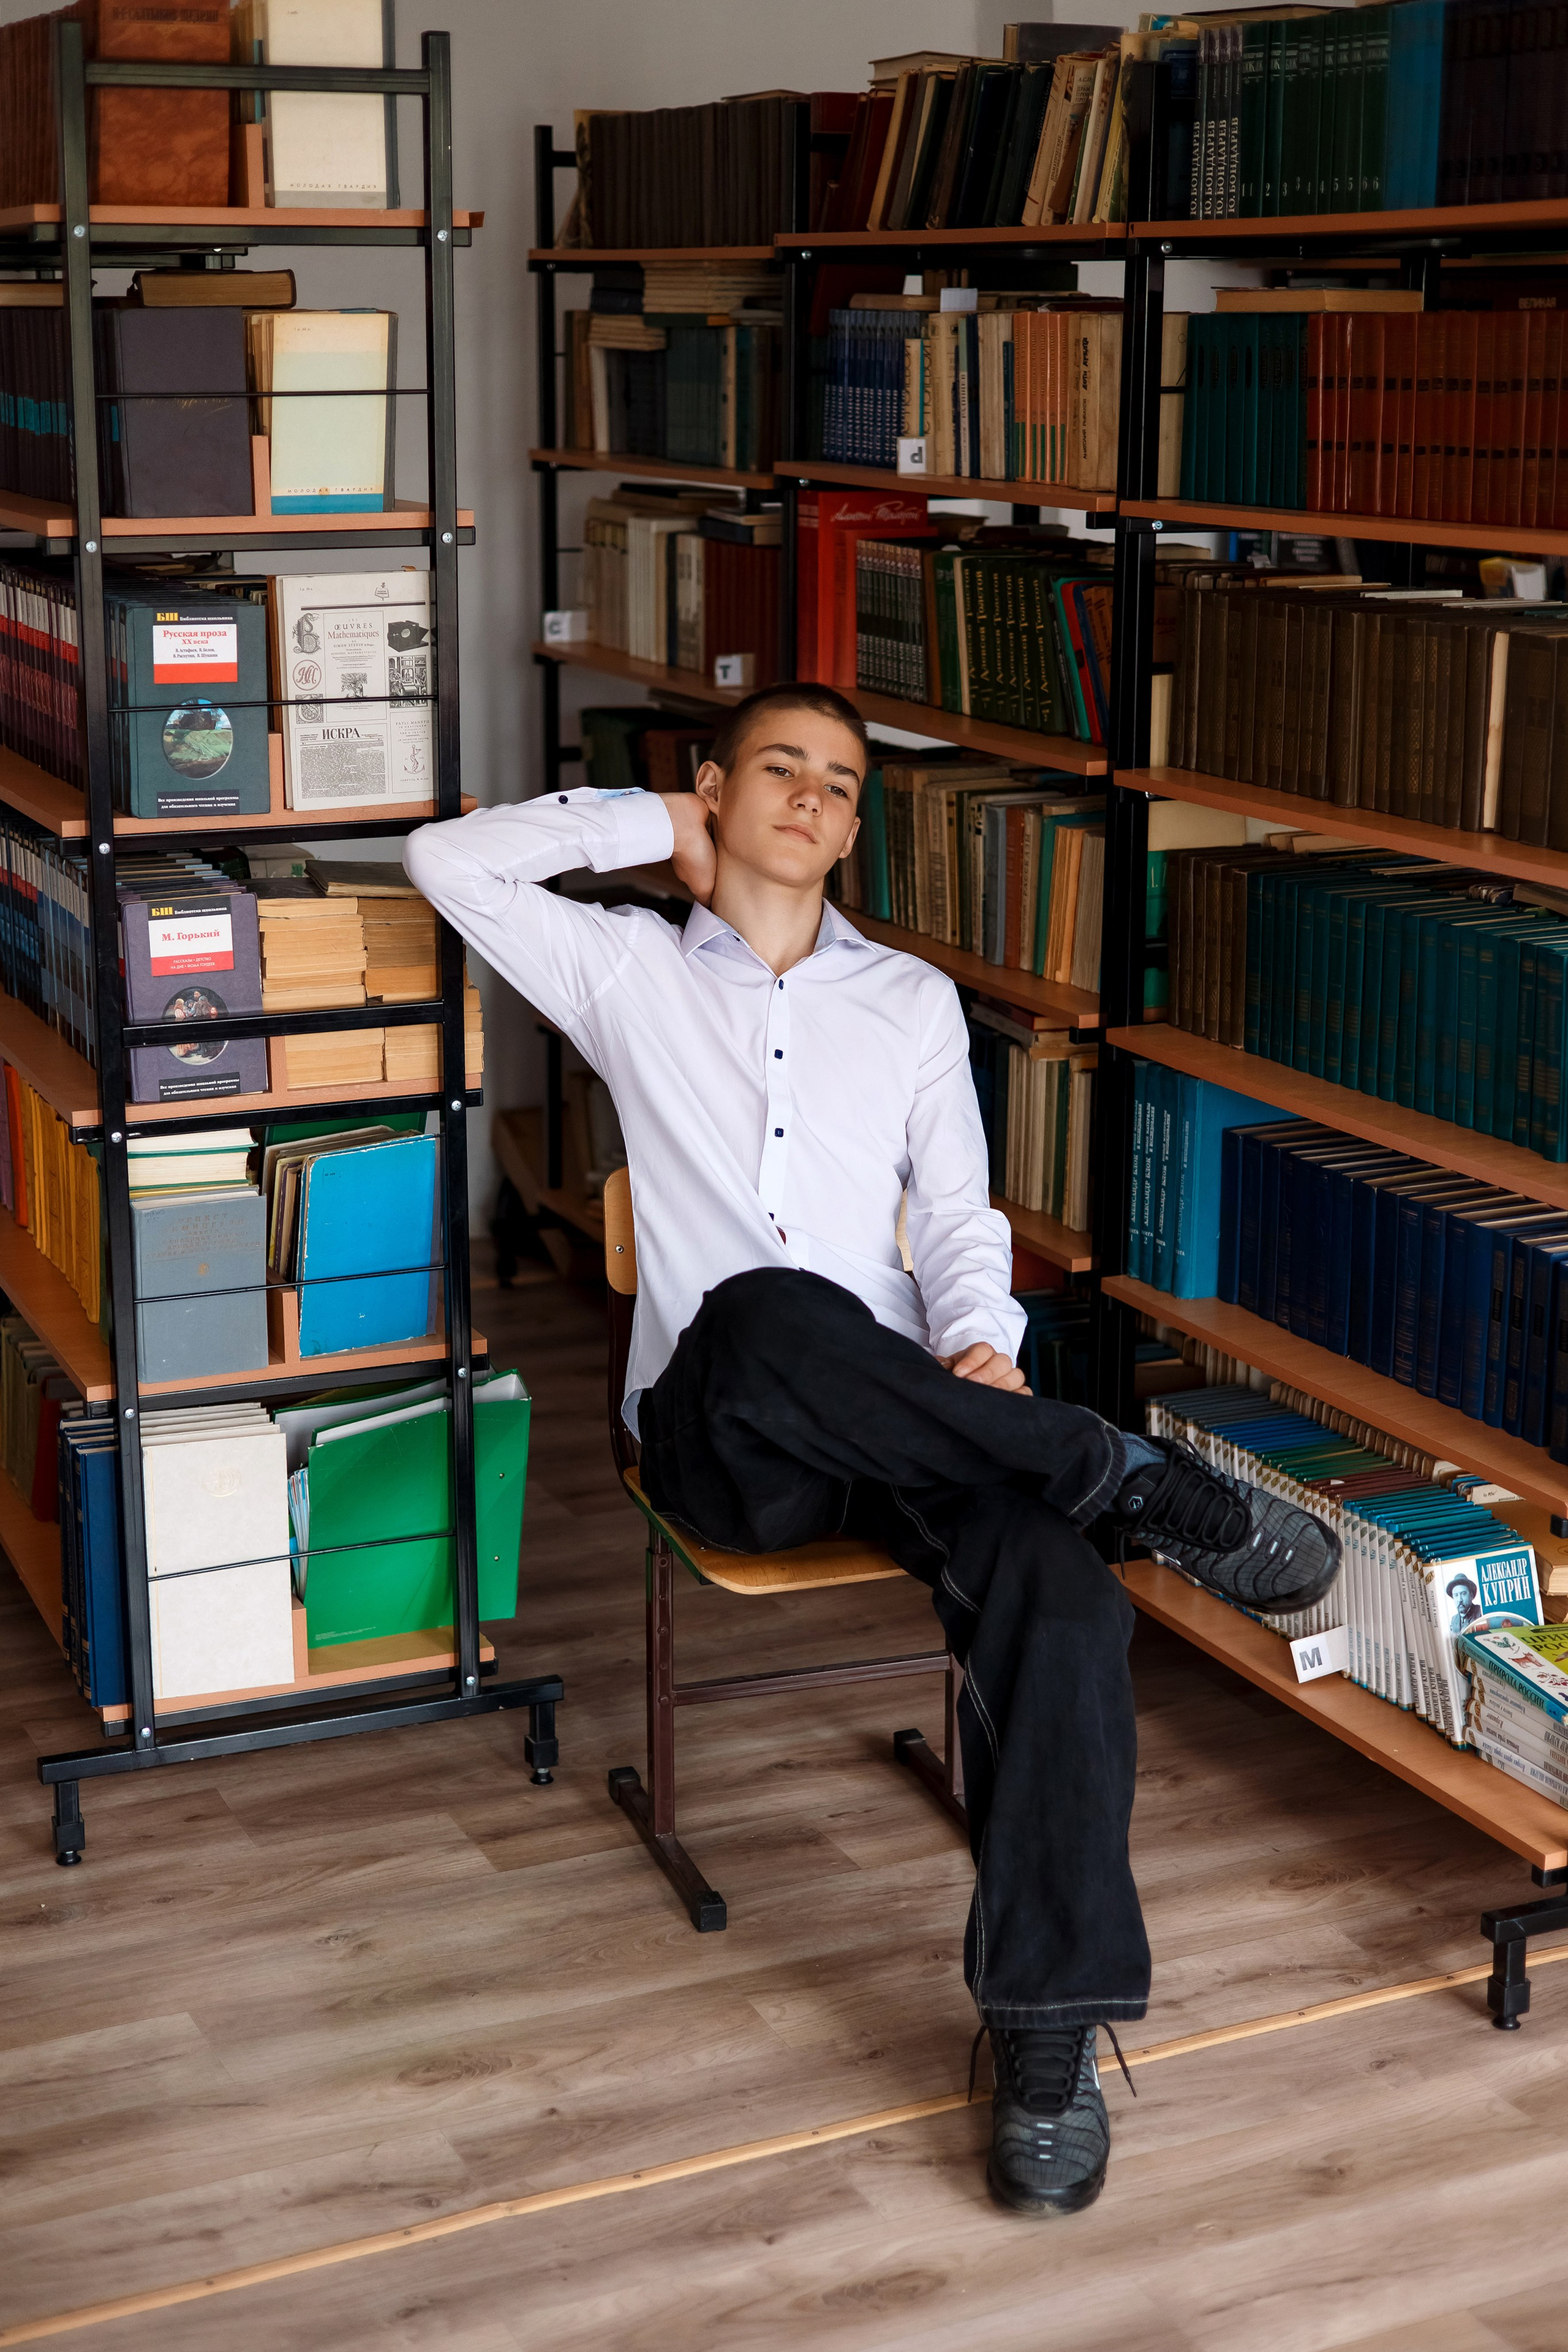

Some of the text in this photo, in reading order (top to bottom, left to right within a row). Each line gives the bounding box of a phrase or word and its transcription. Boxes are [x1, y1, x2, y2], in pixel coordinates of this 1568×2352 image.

[1191, 121, 1200, 194] БОНДАРЕВ
[1205, 120, 1216, 194] БОНДАРЕВ
[1216, 119, 1227, 194] БОНДАРЕВ
[1228, 116, 1239, 190] БОНДАРЕВ
[1333, 178, 1339, 192] 5
[1348, 176, 1354, 191] 5
[1373, 176, 1379, 190] 6
[1006, 575, 1016, 629] Толстой
[156, 612, 178, 622] БШ
[976, 570, 990, 681] Алексей Толстой
[993, 572, 1004, 684] Алексей Толстой
[162, 630, 227, 639] Русская проза
[327, 630, 380, 640] Mathematiques
[1017, 577, 1031, 690] Алексей Толстой
[1033, 579, 1049, 693] Алексей Толстой
[322, 727, 361, 740] ИСКРА
[152, 907, 173, 916] БШ
[162, 929, 221, 941] М. Горький
[1344, 1535, 1351, 1547] Мы
[1352, 1539, 1359, 1550] Мы
[1361, 1546, 1368, 1557] Мы
[1370, 1549, 1376, 1561] Мы
[1379, 1555, 1386, 1566] Мы
[1389, 1559, 1396, 1570] Мы
[1480, 1556, 1528, 1583] АЛЕКСАНДР
[1482, 1575, 1532, 1608] КУПРИН
[1298, 1647, 1322, 1670] М
[1408, 1652, 1421, 1710] АЛЕКСАНДР КУПРИН
[1419, 1659, 1433, 1717] АЛЕКСАНДР КУПРИН
[1488, 1660, 1545, 1709] ПРИРОДА РОССИИ
[1428, 1667, 1441, 1725] АЛЕКСАНДР КУПРИН
[1441, 1679, 1455, 1738] АЛЕКСАНДР КУПРИН
